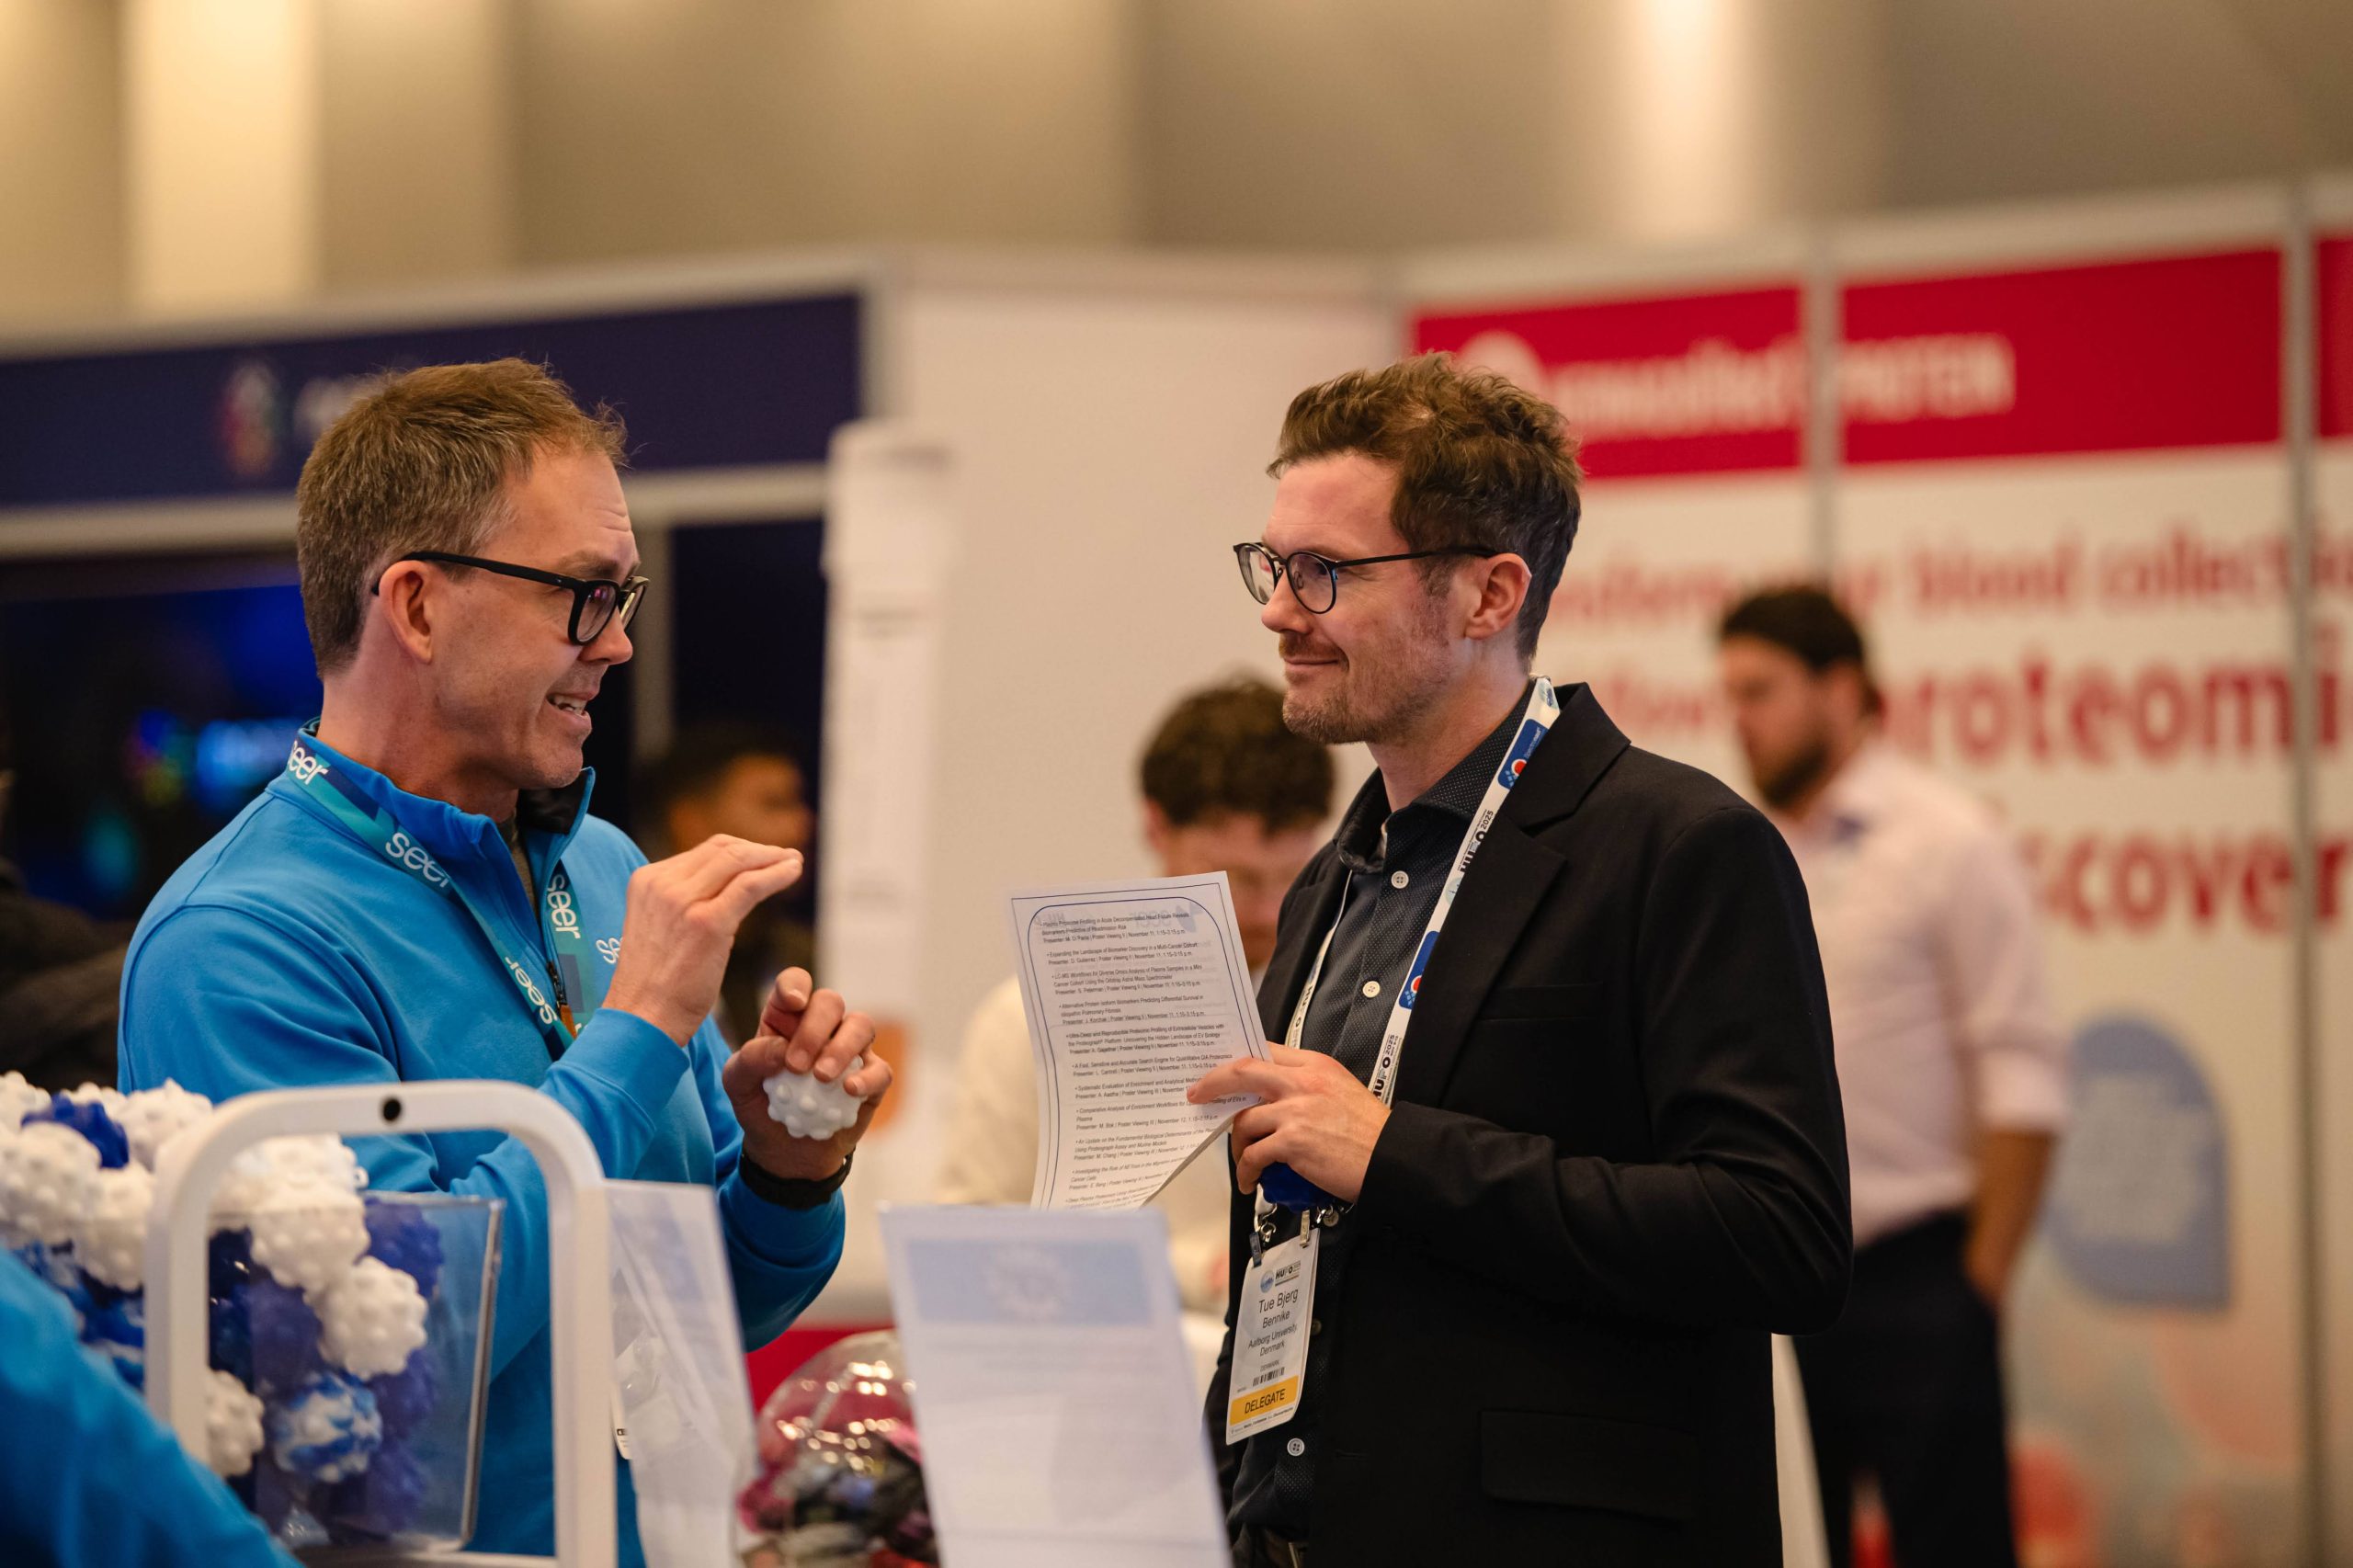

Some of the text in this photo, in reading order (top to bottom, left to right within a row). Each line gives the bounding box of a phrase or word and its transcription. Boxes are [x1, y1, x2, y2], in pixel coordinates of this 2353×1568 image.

[546, 873, 582, 939] seer
[595, 936, 627, 965] se
[505, 955, 558, 1026] seer
[1258, 1289, 1299, 1314] Tue Bjerg
[1262, 1310, 1290, 1329] Bennike
[1248, 1324, 1298, 1349] Aalborg University
[1259, 1339, 1286, 1357] Denmark
[1245, 1388, 1286, 1415] DELEGATE
